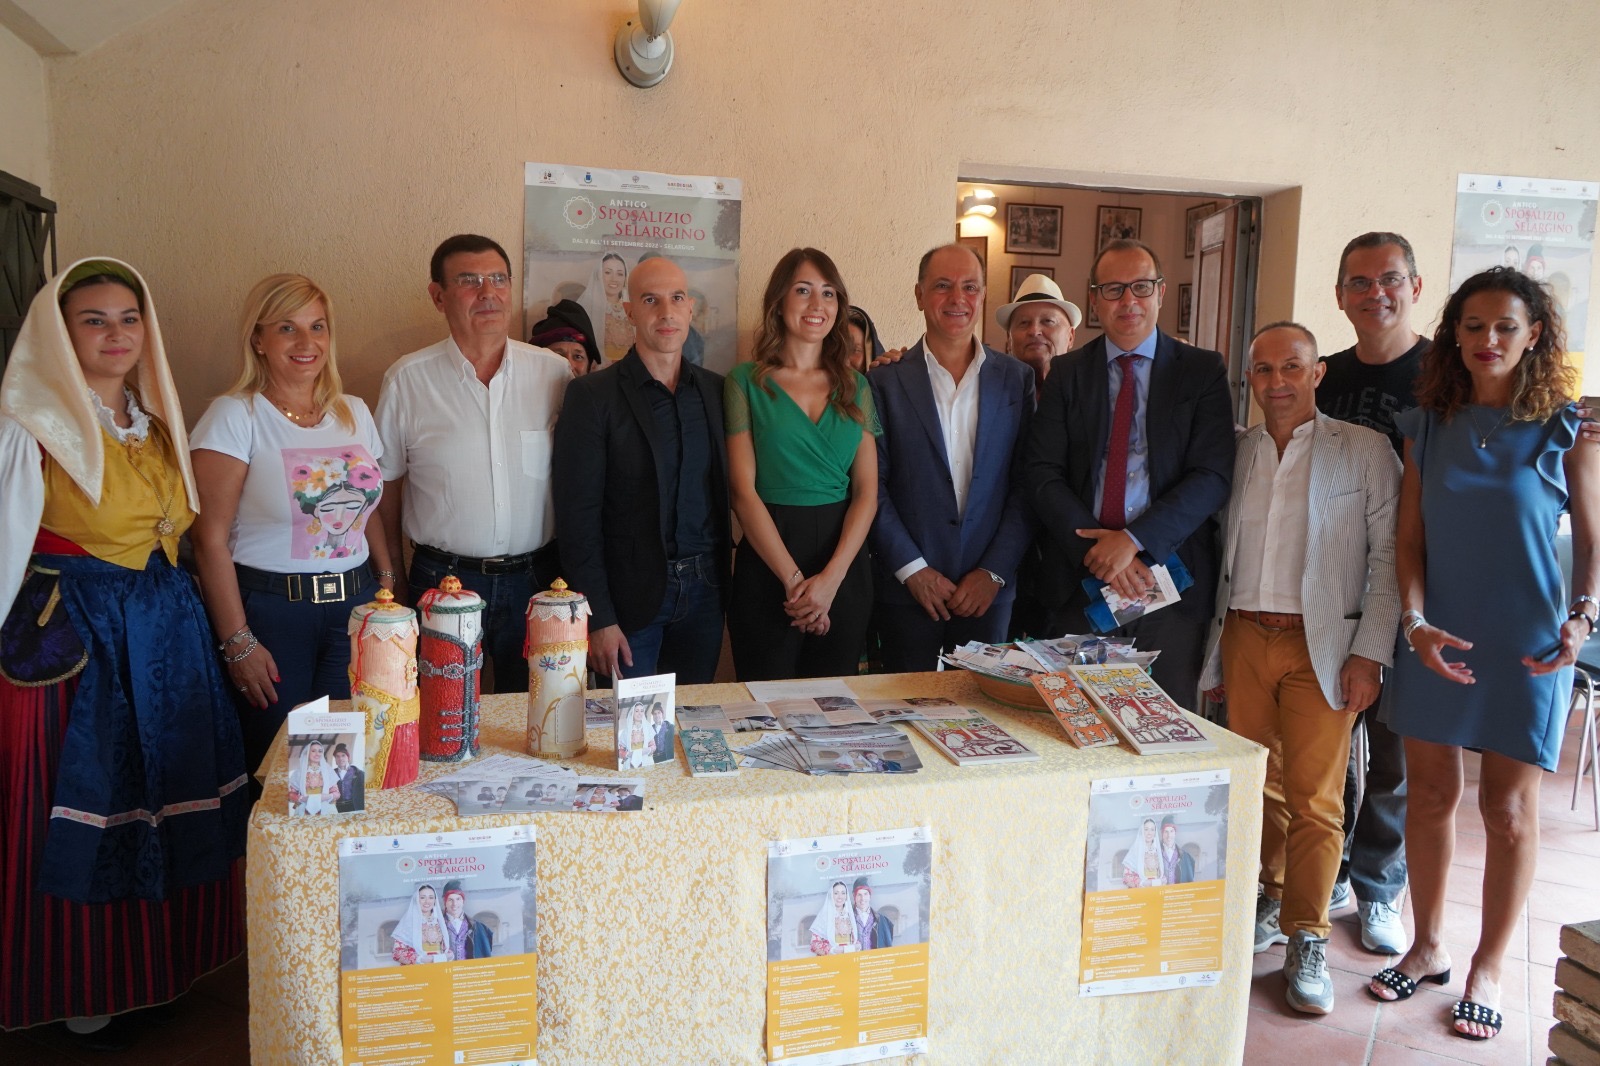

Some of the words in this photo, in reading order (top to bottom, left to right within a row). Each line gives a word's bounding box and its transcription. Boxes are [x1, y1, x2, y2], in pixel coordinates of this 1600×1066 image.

[609, 199, 648, 209] ANTICO
[598, 205, 692, 225] SPOSALIZIO
[1504, 207, 1566, 222] SPOSALIZIO
[614, 221, 706, 241] SELARGINO
[1514, 219, 1573, 234] SELARGINO
[611, 240, 644, 248] SETTEMBRE
[1151, 800, 1193, 811] SELARGINO
[417, 856, 477, 868] SPOSALIZIO
[832, 854, 882, 866] SPOSALIZIO
[427, 863, 486, 875] SELARGINO
[840, 861, 889, 873] SELARGINO
